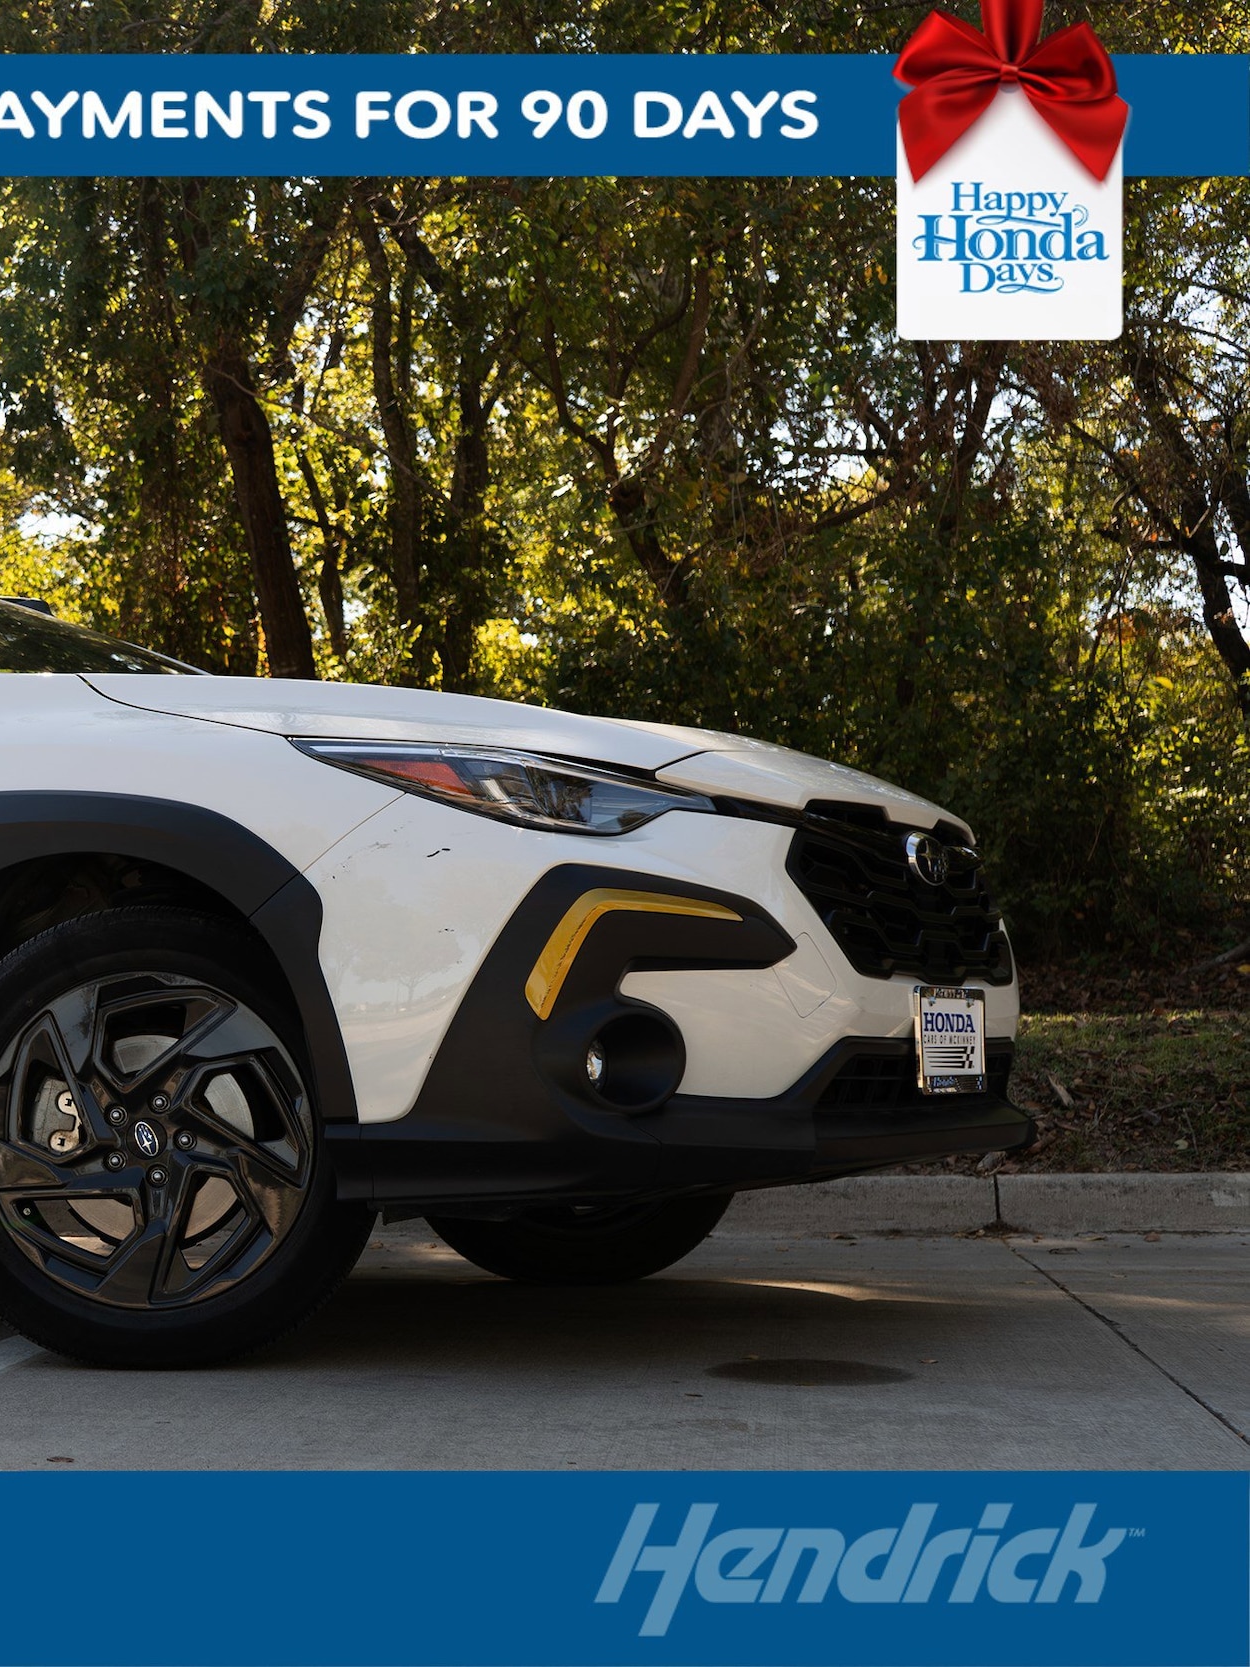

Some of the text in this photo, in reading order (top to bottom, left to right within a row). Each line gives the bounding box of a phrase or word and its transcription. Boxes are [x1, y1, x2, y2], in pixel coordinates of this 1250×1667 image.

[923, 1012, 976, 1033] HONDA
[923, 1034, 937, 1044] CARS
[940, 1035, 947, 1044] OF
